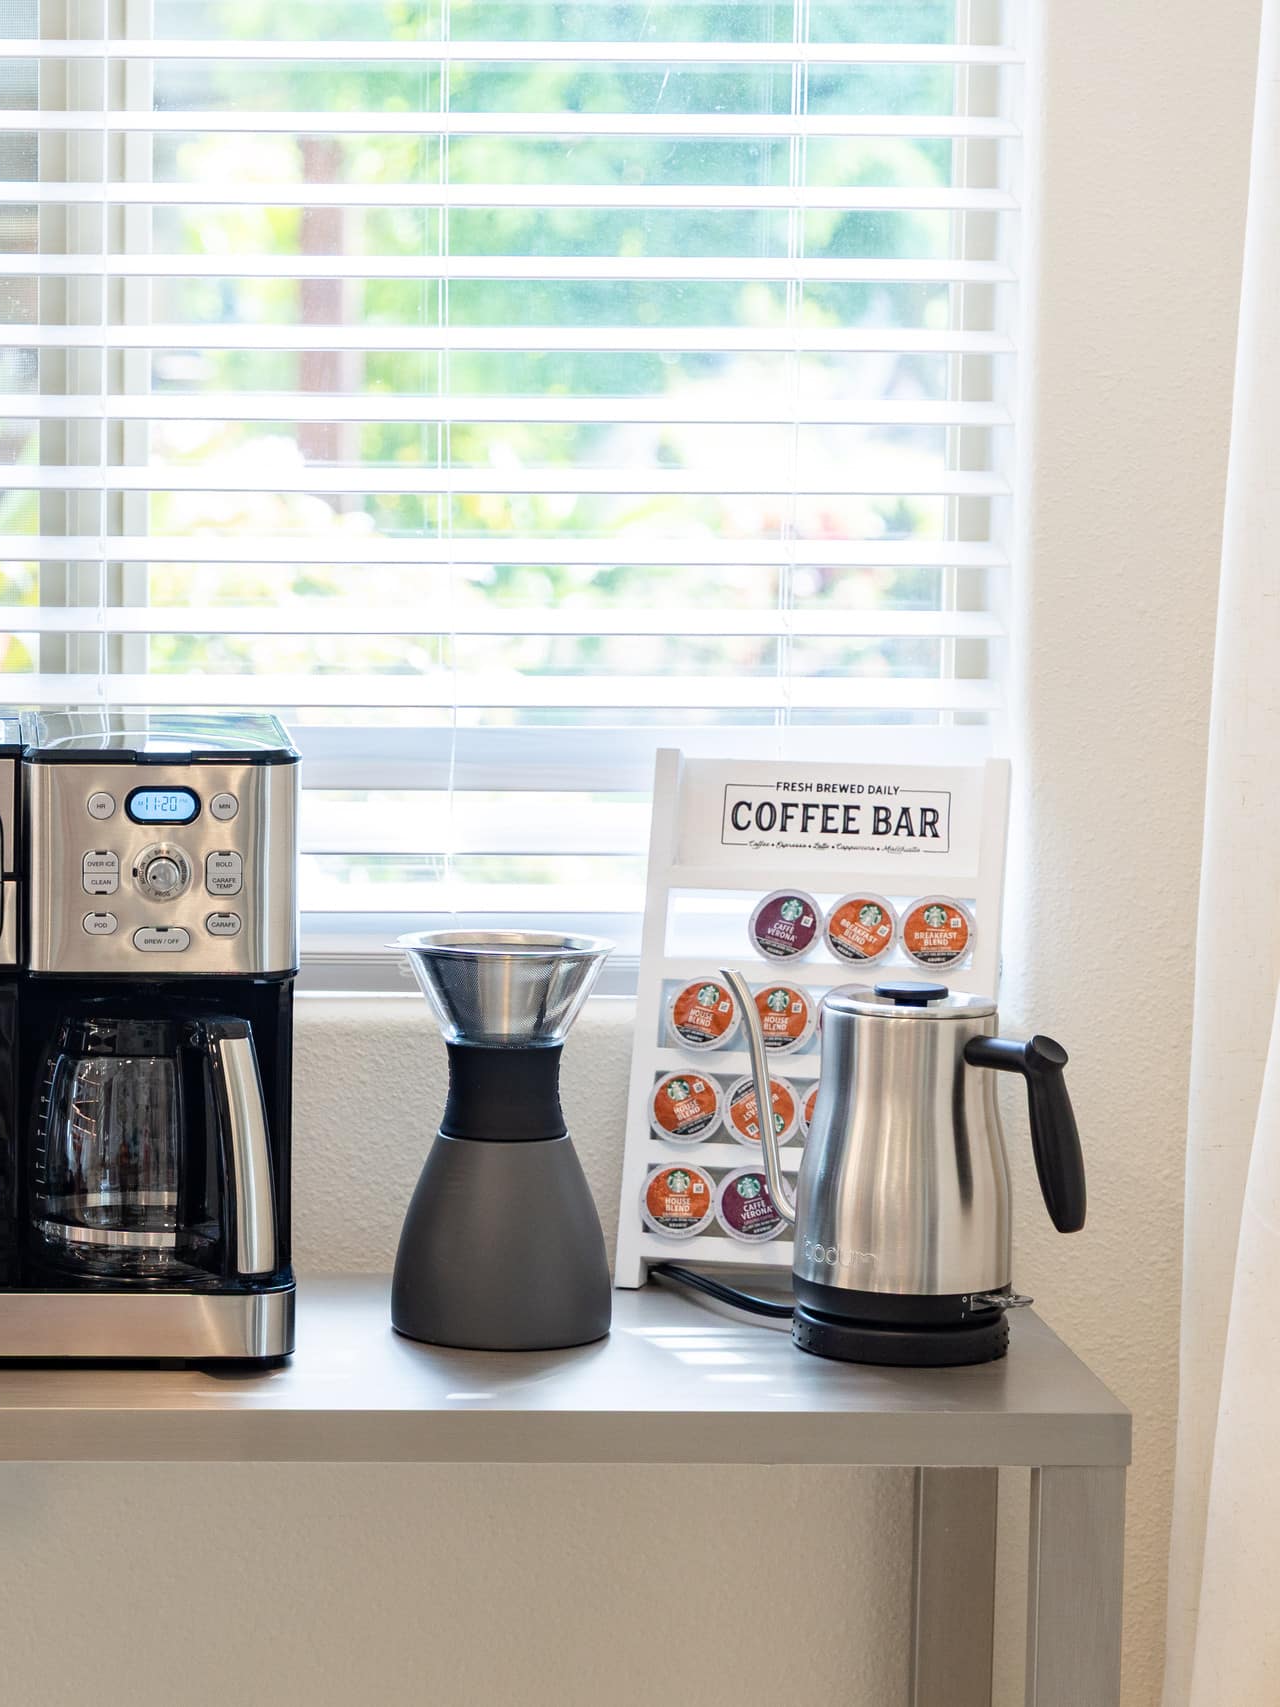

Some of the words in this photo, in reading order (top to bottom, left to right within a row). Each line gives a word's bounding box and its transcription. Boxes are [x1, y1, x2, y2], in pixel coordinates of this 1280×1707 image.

[776, 781, 813, 792] FRESH
[816, 783, 864, 793] BREWED
[867, 784, 901, 795] DAILY
[145, 796, 177, 811] 11:20
[731, 800, 861, 834] COFFEE
[872, 805, 940, 838] BAR
[840, 918, 878, 944] BREAKFAST
[843, 929, 866, 945] BLEND
[923, 938, 949, 946] BLEND
[687, 1015, 711, 1028] BLEND
[690, 1008, 714, 1021] HOUSE
[764, 1016, 789, 1025] HOUSE
[763, 1023, 787, 1031] BLEND
[673, 1099, 699, 1114] HOUSE
[677, 1106, 701, 1121] BLEND
[665, 1197, 691, 1206] HOUSE
[665, 1204, 690, 1212] BLEND
[740, 1206, 773, 1220] VERONA
[803, 1234, 879, 1267] bodum
